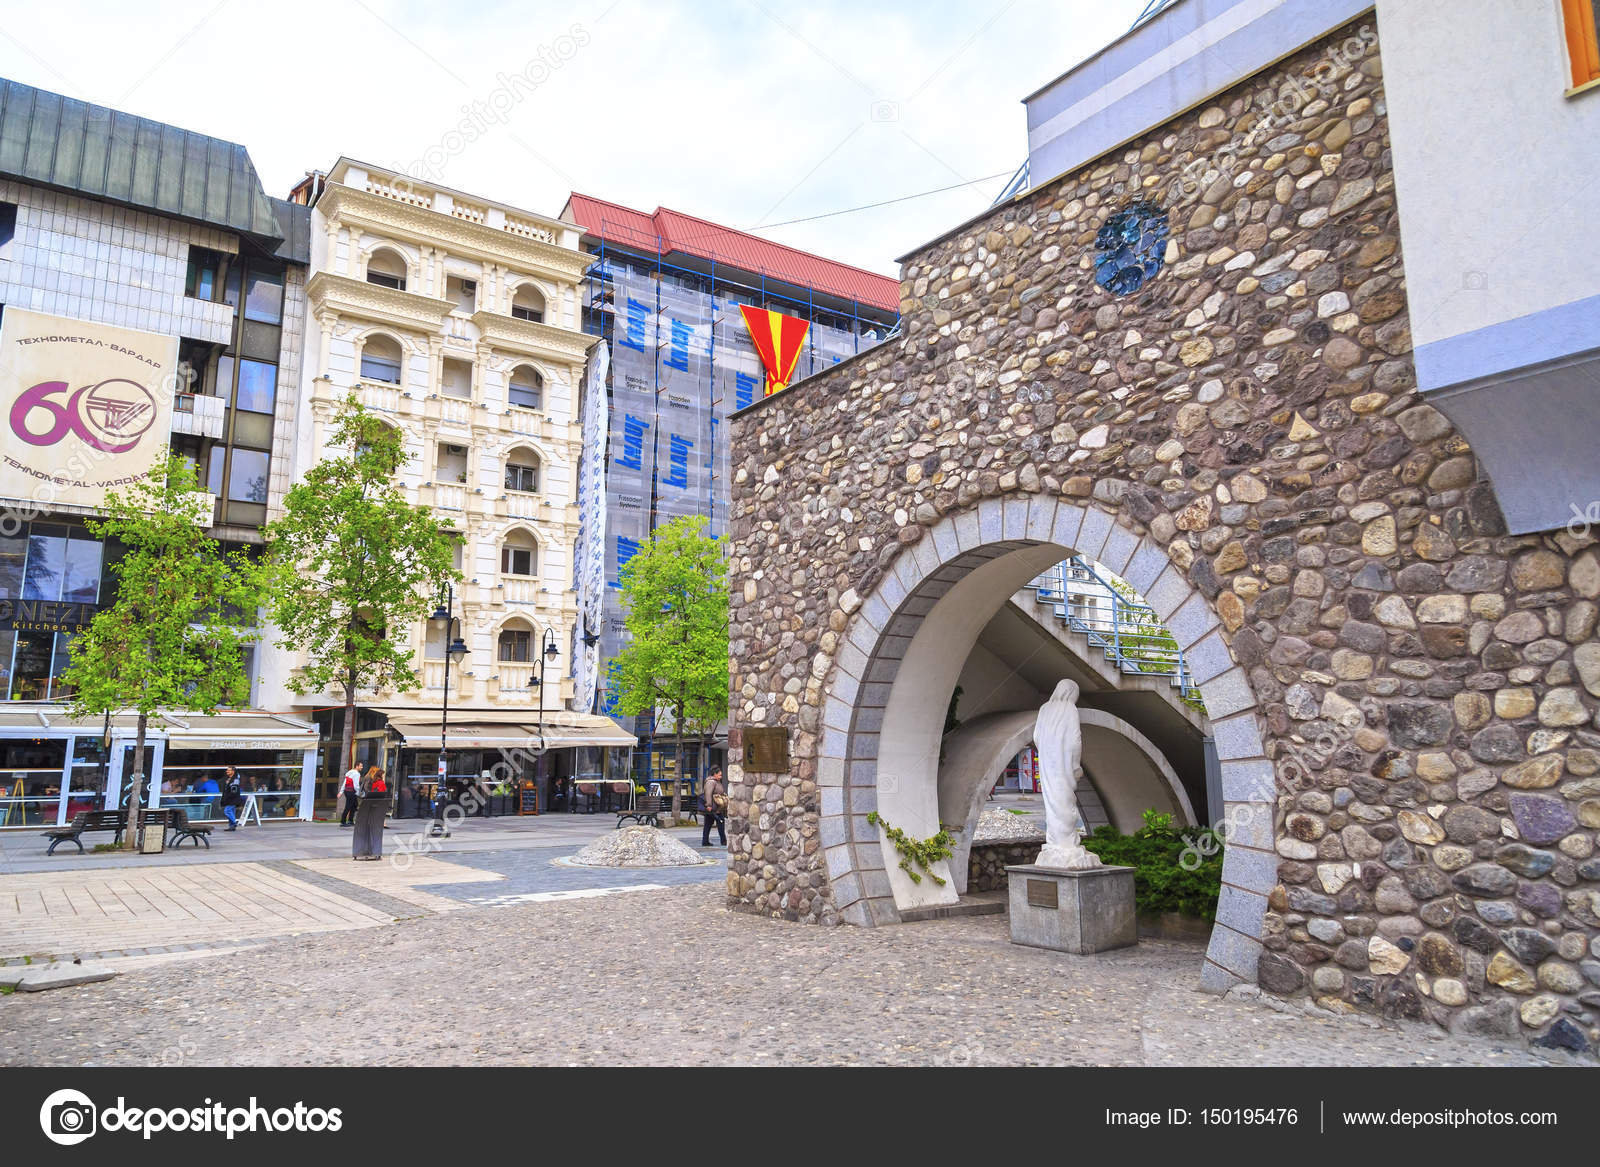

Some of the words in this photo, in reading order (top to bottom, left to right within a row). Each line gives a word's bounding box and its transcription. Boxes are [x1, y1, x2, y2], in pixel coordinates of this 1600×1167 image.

[16, 335, 161, 369] ТЕХНОМЕТАЛ-ВАРДАР
[3, 455, 151, 488] TEHNOMETAL-VARDAR
[12, 621, 68, 631] Kitchen
